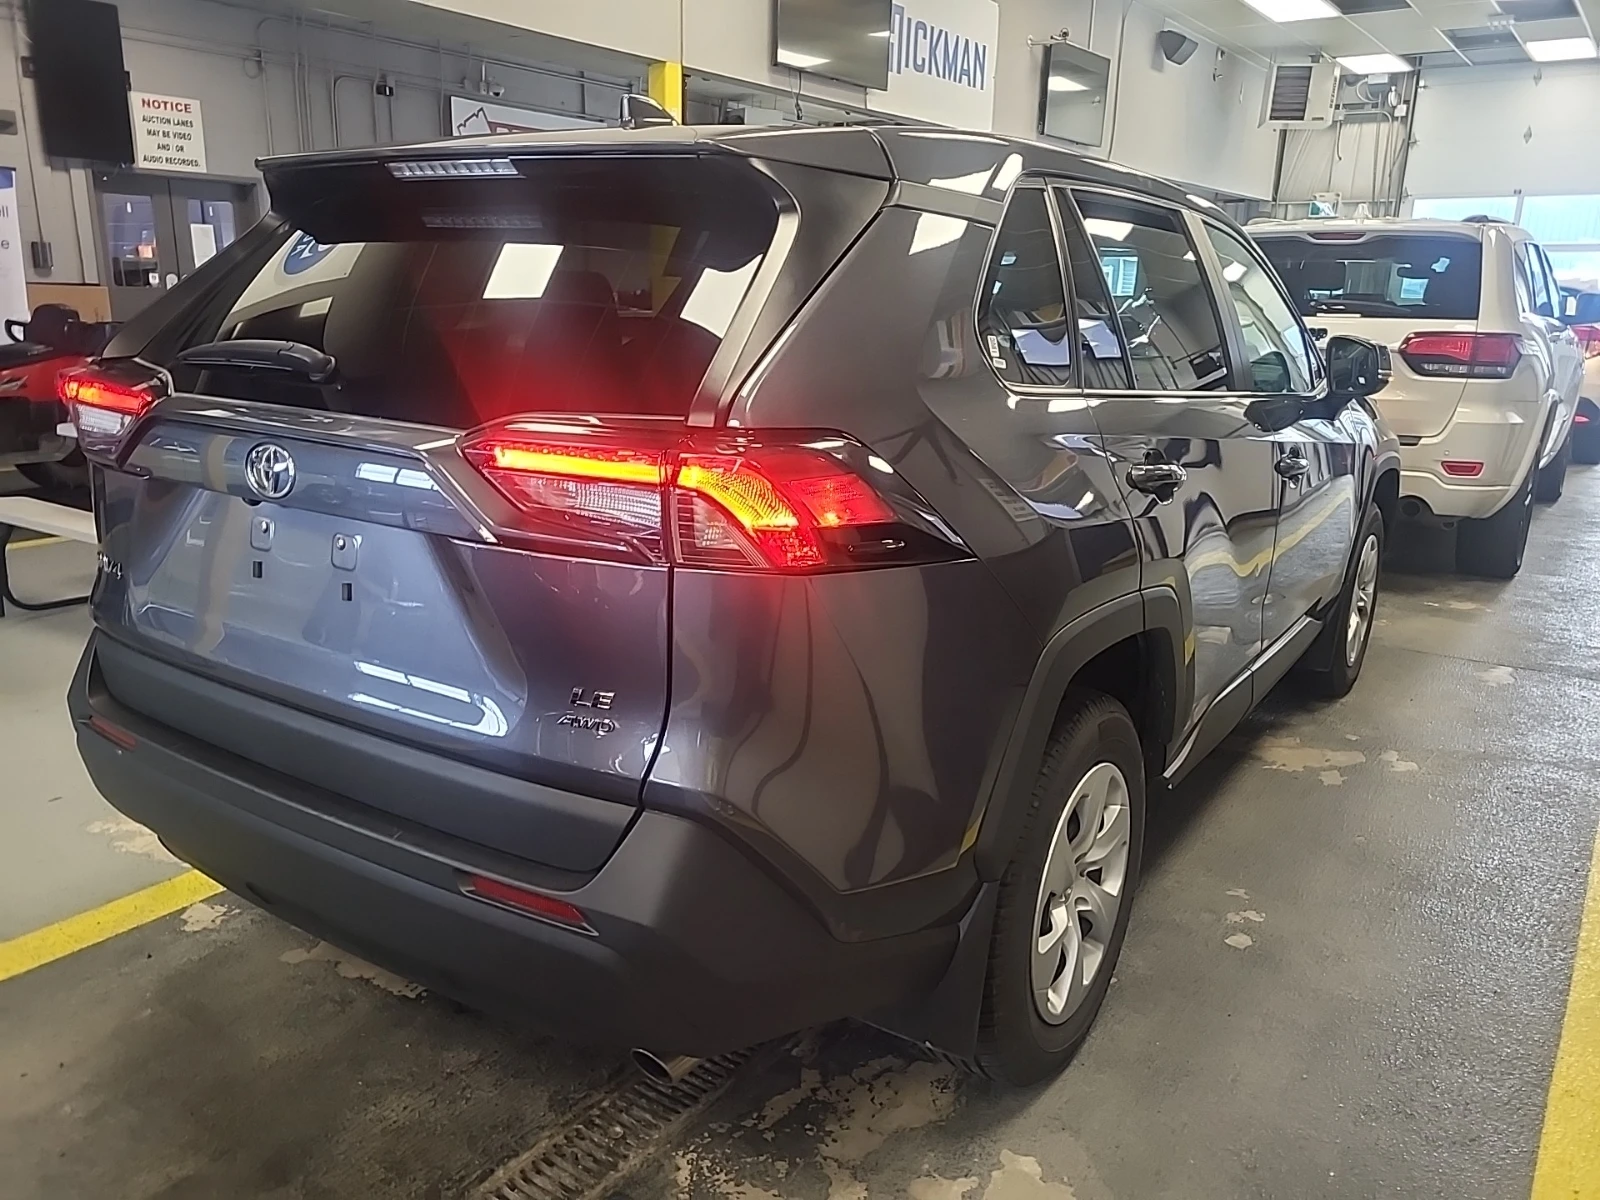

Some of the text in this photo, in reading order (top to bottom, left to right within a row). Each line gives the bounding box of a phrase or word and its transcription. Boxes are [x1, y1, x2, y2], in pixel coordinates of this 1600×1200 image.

[141, 98, 192, 113] NOTICE
[142, 114, 194, 128] AUCTION LANES
[146, 128, 192, 141] MAY BE VIDEO
[157, 143, 170, 151] AND
[175, 144, 184, 153] OR
[143, 154, 201, 167] AUDIO RECORDED.
[569, 687, 616, 710] LE
[556, 714, 616, 733] AWD
